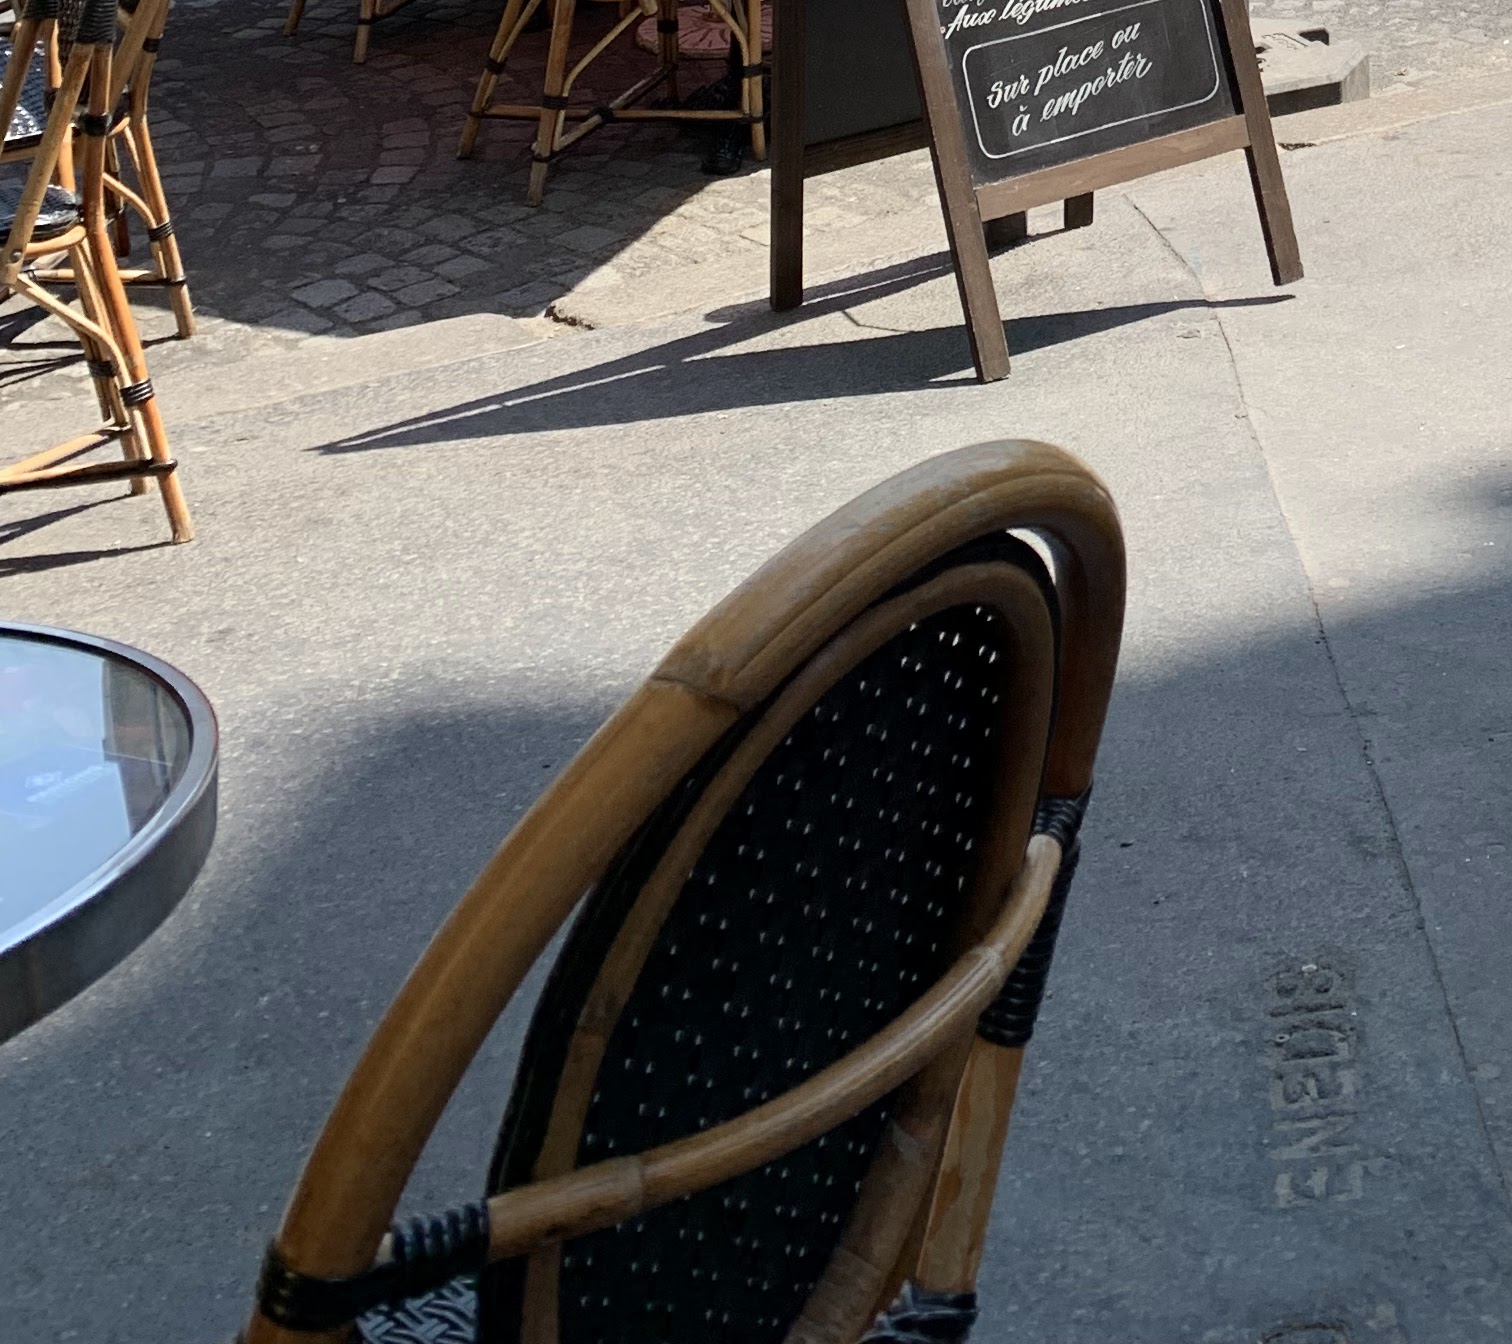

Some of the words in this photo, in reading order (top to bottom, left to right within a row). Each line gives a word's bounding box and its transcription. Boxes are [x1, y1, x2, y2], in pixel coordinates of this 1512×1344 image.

[945, 4, 997, 39] Aux
[987, 75, 1030, 108] Sur
[1034, 40, 1104, 96] place
[1111, 22, 1141, 49] ou
[1012, 105, 1031, 137] à
[1040, 52, 1152, 122] emporter
